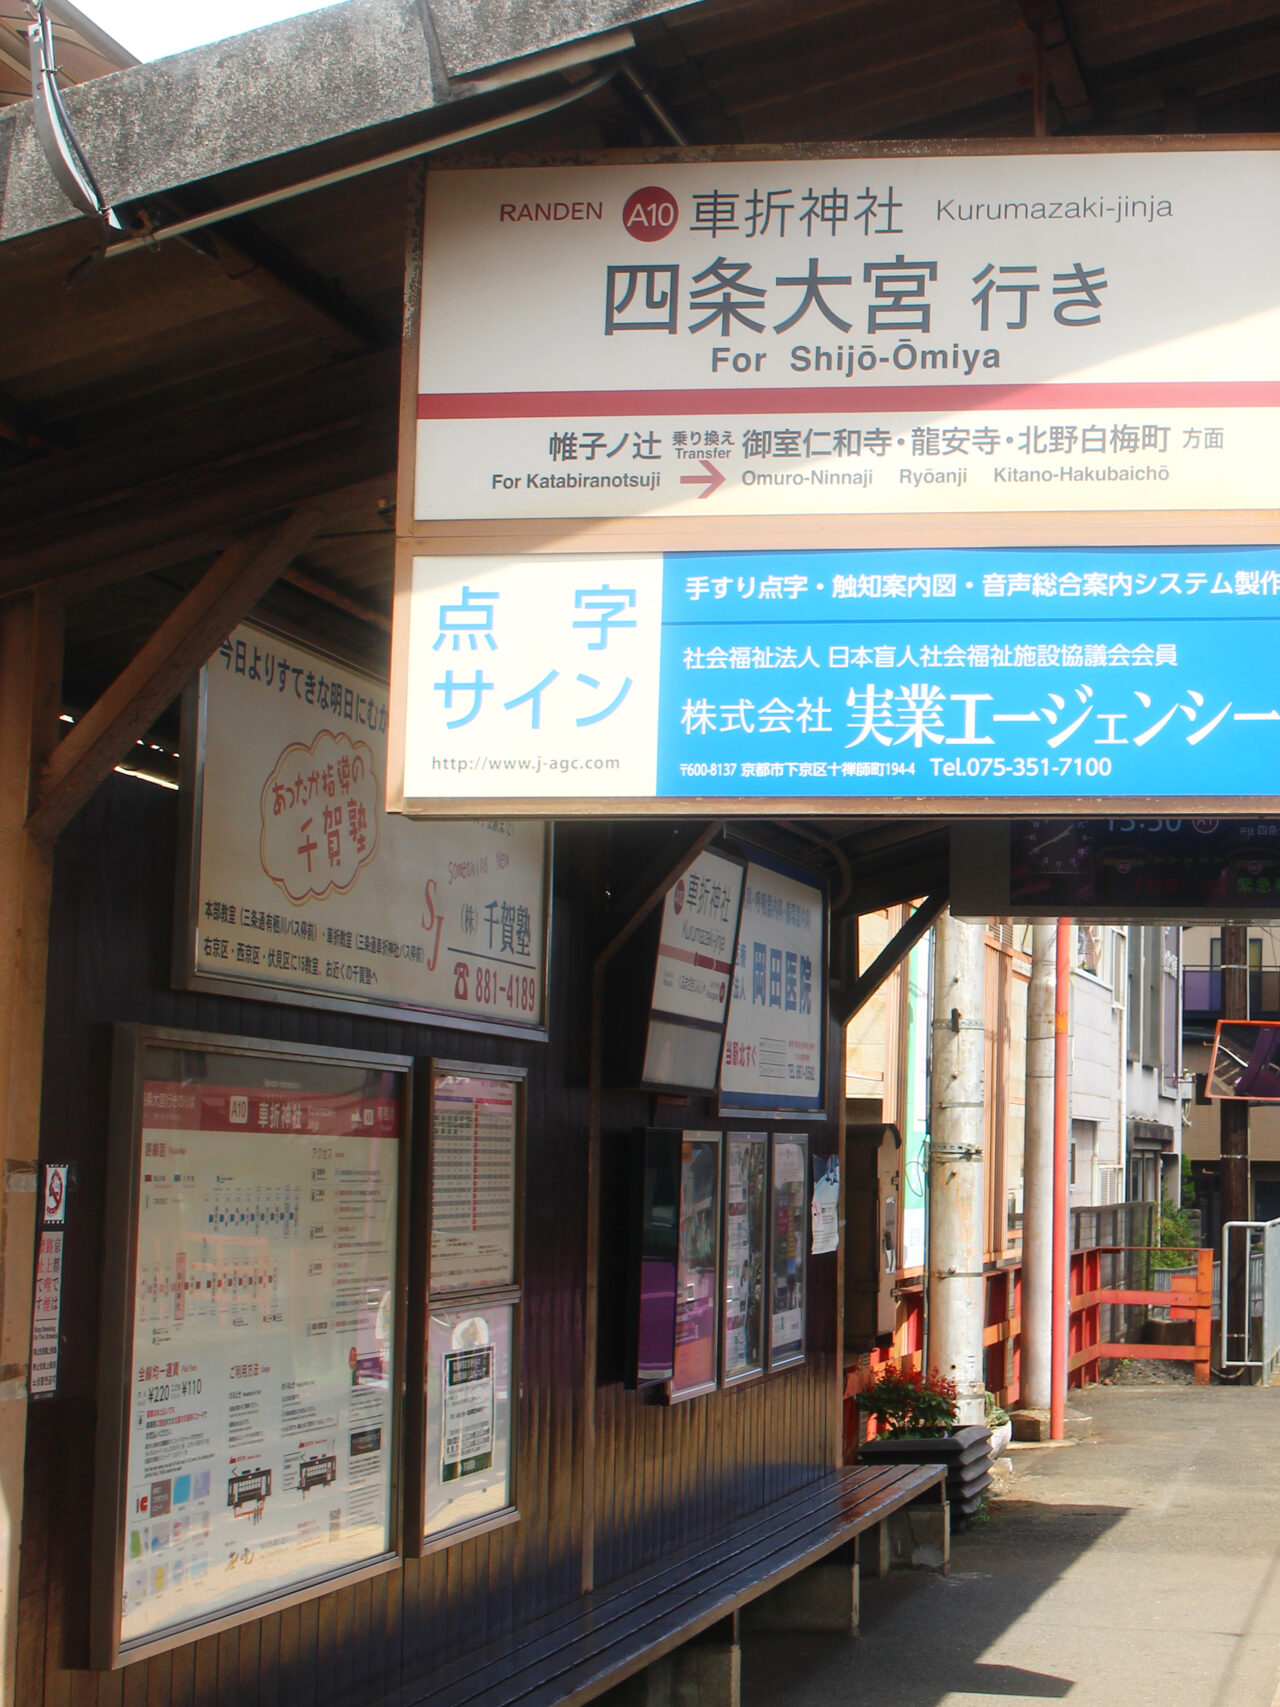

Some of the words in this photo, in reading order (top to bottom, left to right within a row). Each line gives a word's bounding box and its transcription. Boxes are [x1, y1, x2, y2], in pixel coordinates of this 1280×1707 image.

[500, 202, 604, 222] RANDEN
[627, 202, 674, 227] A10
[690, 186, 904, 238] 車折神社
[937, 195, 1173, 223] Kurumazaki-jinja
[604, 254, 938, 336] 四条大宮
[971, 262, 1108, 331] 行き
[711, 347, 767, 372] For
[790, 339, 1000, 377] Shijō-Ōmiya
[549, 432, 662, 461] 帷子ノ辻
[672, 430, 735, 446] 乗り換え
[742, 424, 1171, 459] 御室仁和寺・龍安寺・北野白梅町
[1182, 427, 1224, 450] 方面
[675, 447, 731, 459] Transfer
[492, 474, 522, 489] For
[527, 470, 660, 490] Katabiranotsuji
[742, 468, 873, 487] Omuro-Ninnaji
[900, 467, 967, 485] Ryōanji
[994, 465, 1170, 483] Kitano-Hakubaichō
[432, 584, 637, 651] 点字
[683, 646, 820, 670] 社会福祉法人
[829, 644, 1177, 669] 日本盲人社会福祉施設協議会会員
[433, 669, 633, 730] サイン
[680, 697, 833, 735] 株式会社
[432, 754, 620, 774] http://www.j-agc.com
[930, 757, 1112, 777] Tel.075-351-7100
[297, 800, 368, 873] 千賀塾
[686, 872, 731, 923] 車折神社
[476, 966, 535, 1012] 881-4189
[231, 1101, 247, 1119] A10
[258, 1102, 303, 1129] 車折神社
[148, 1384, 170, 1403] ¥220
[181, 1378, 203, 1397] ¥110
